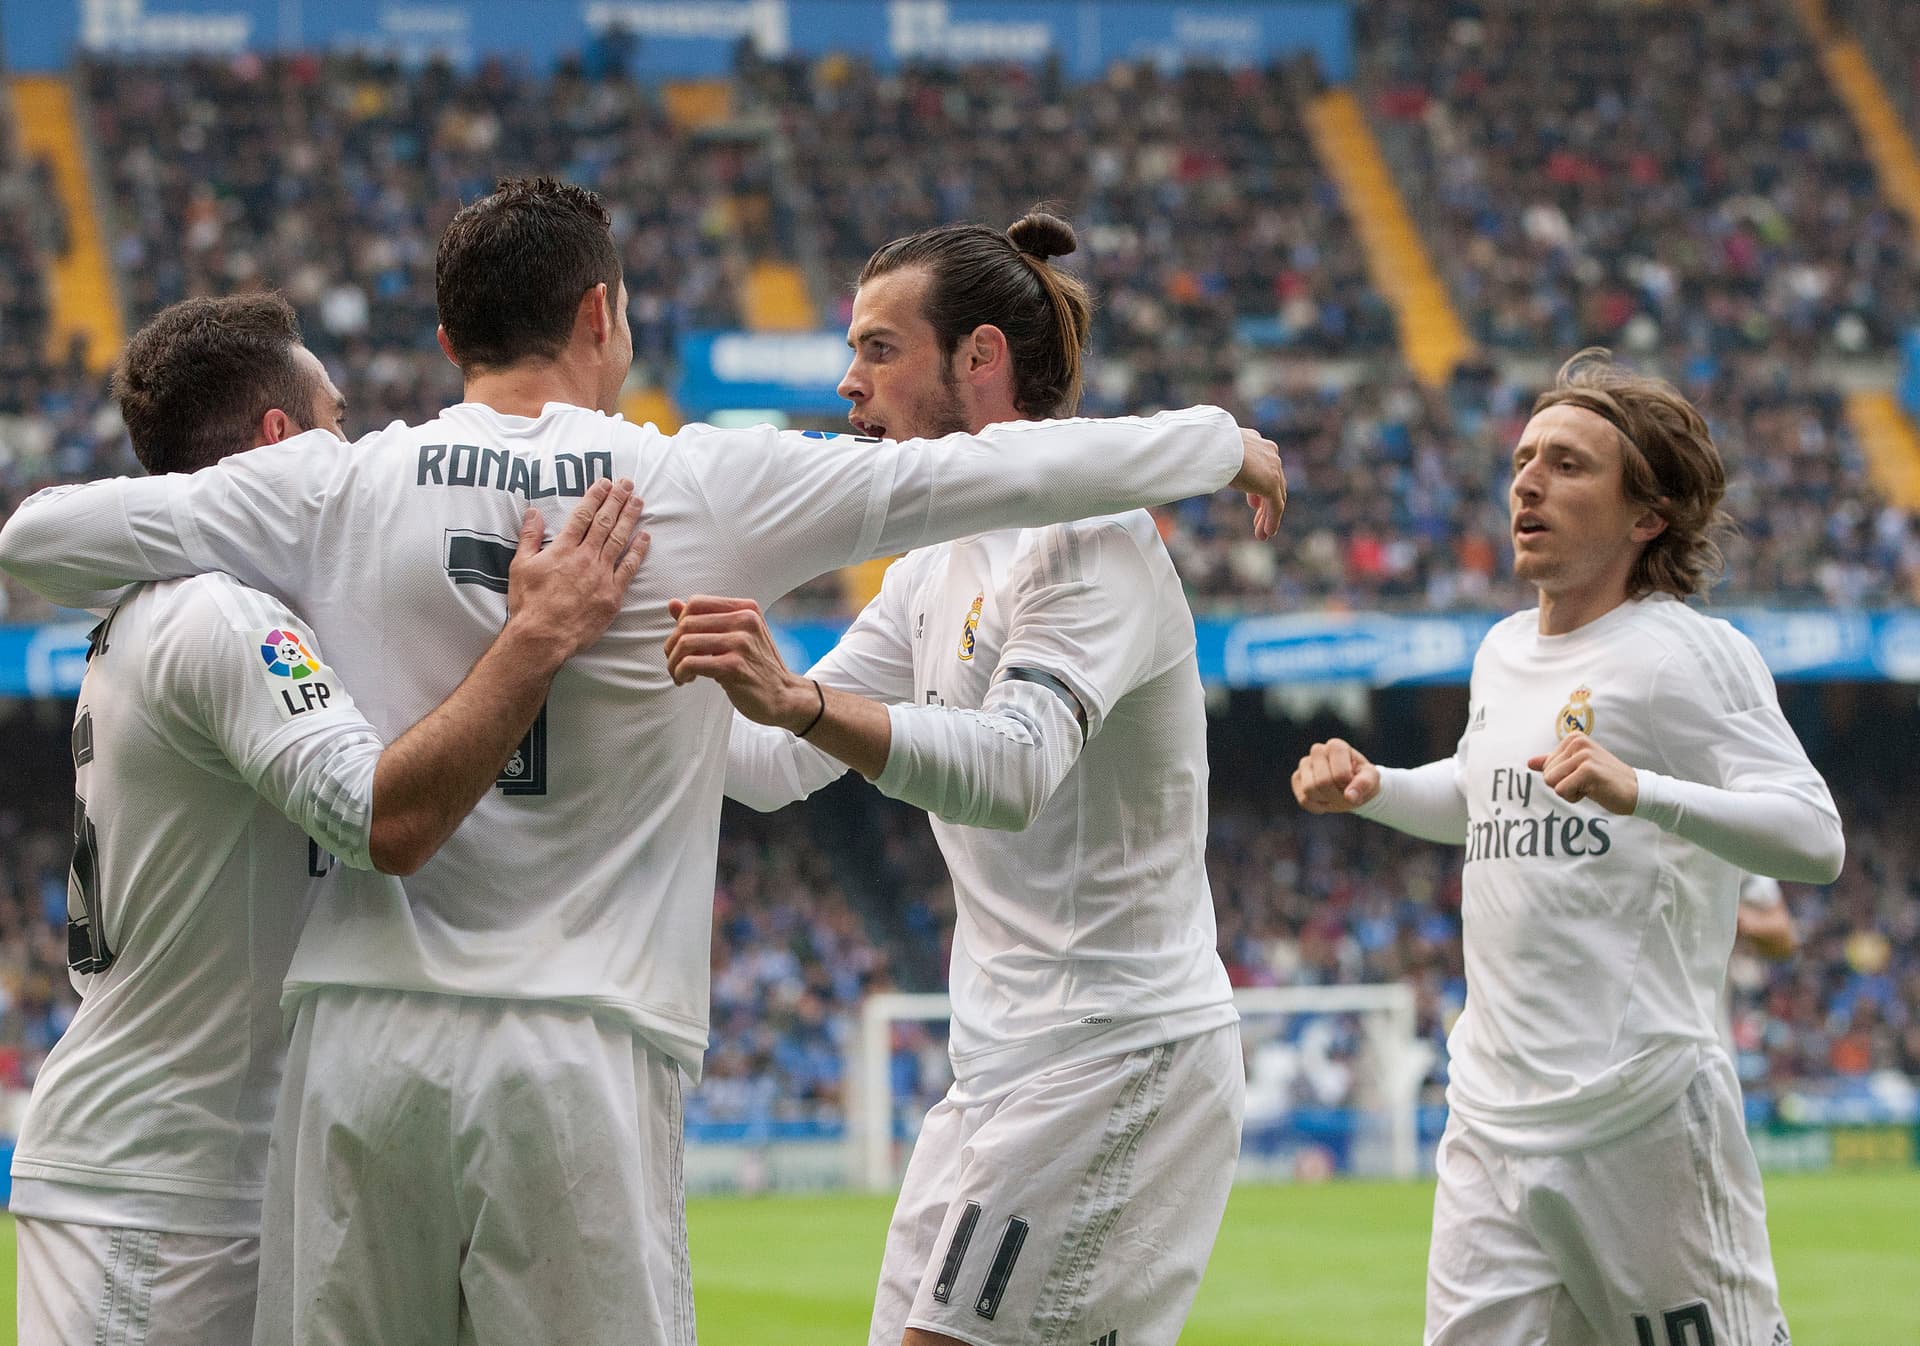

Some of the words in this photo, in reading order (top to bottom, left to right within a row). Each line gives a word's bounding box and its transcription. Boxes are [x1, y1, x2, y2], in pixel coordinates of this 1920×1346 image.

[417, 444, 613, 500] RONALDO
[281, 683, 331, 716] LFP
[1492, 768, 1532, 807] Fly
[1465, 807, 1611, 862] mirates
[1080, 1016, 1112, 1025] adizero
[932, 1200, 1030, 1320] 11
